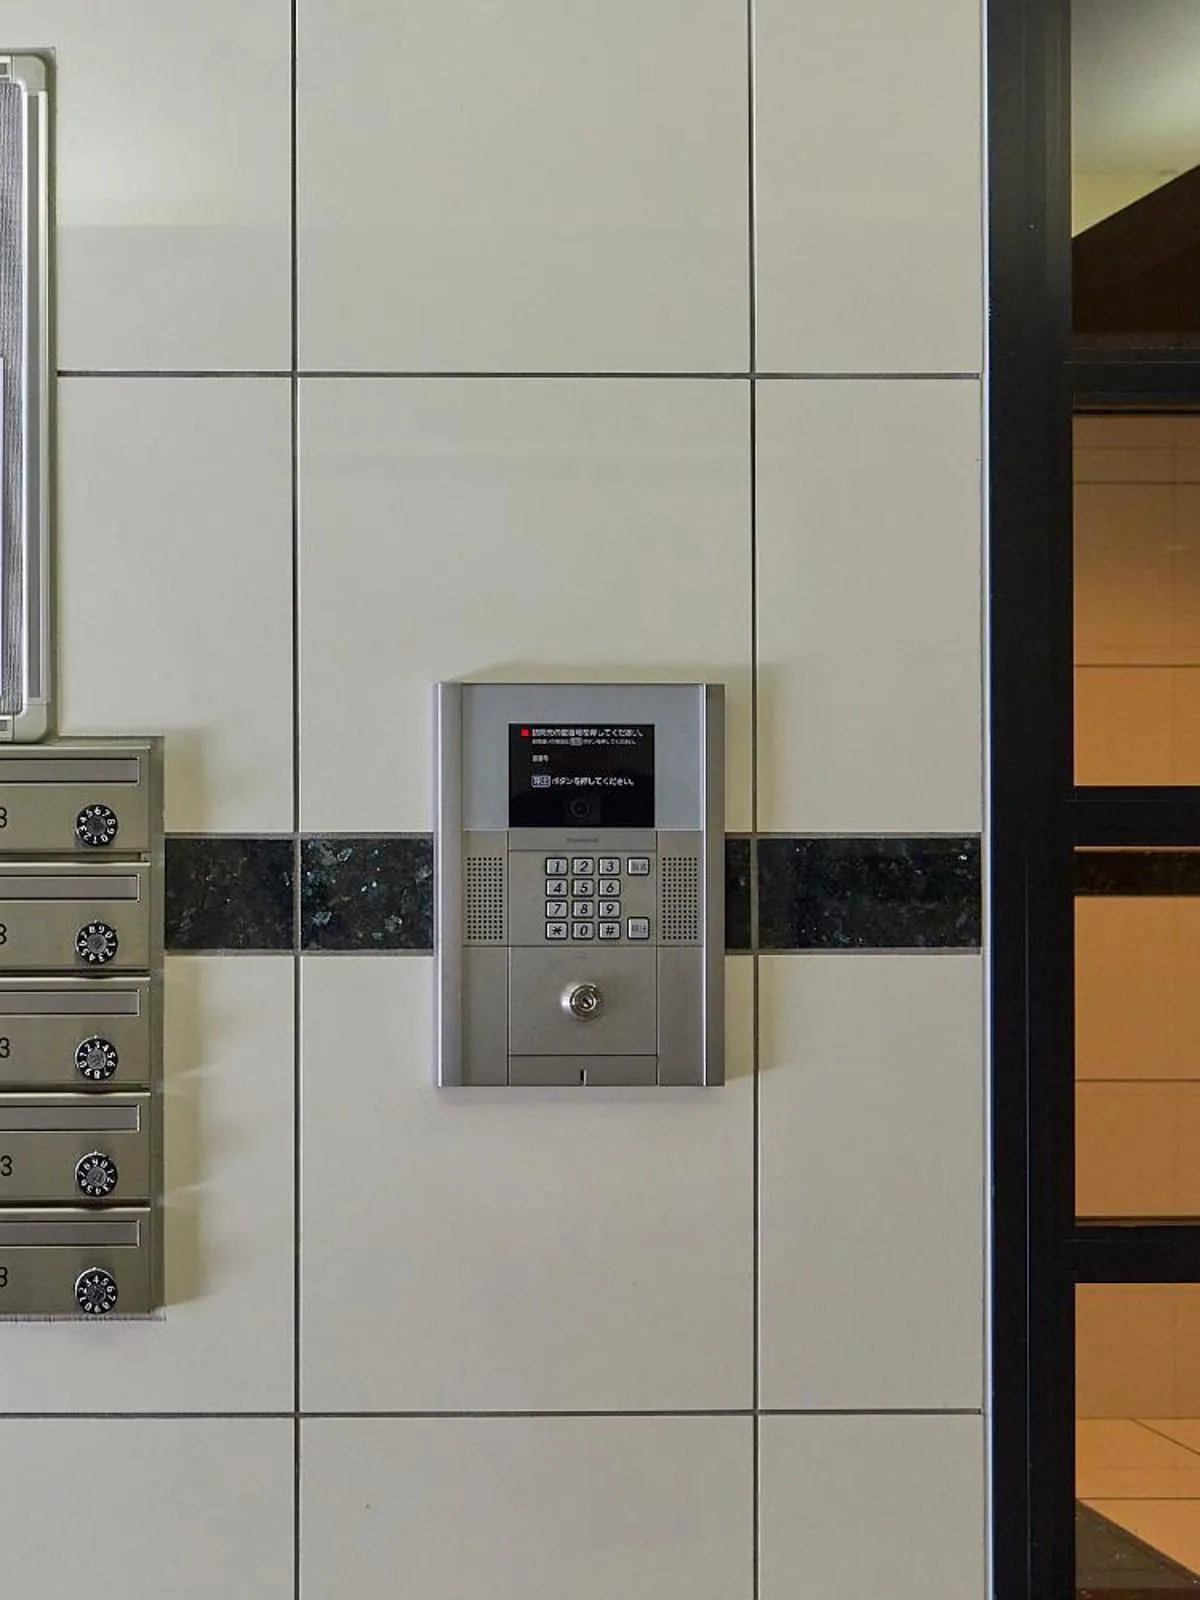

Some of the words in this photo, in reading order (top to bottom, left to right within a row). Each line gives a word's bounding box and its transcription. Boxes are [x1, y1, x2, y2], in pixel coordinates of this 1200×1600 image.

[554, 861, 561, 873] 1
[579, 860, 589, 873] 2
[605, 861, 614, 873] 3
[552, 882, 563, 893] 4
[579, 882, 589, 894] 5
[605, 882, 615, 894] 6
[553, 903, 563, 915] 7
[579, 903, 589, 915] 8
[606, 903, 615, 915] 9
[579, 924, 589, 937] 0
